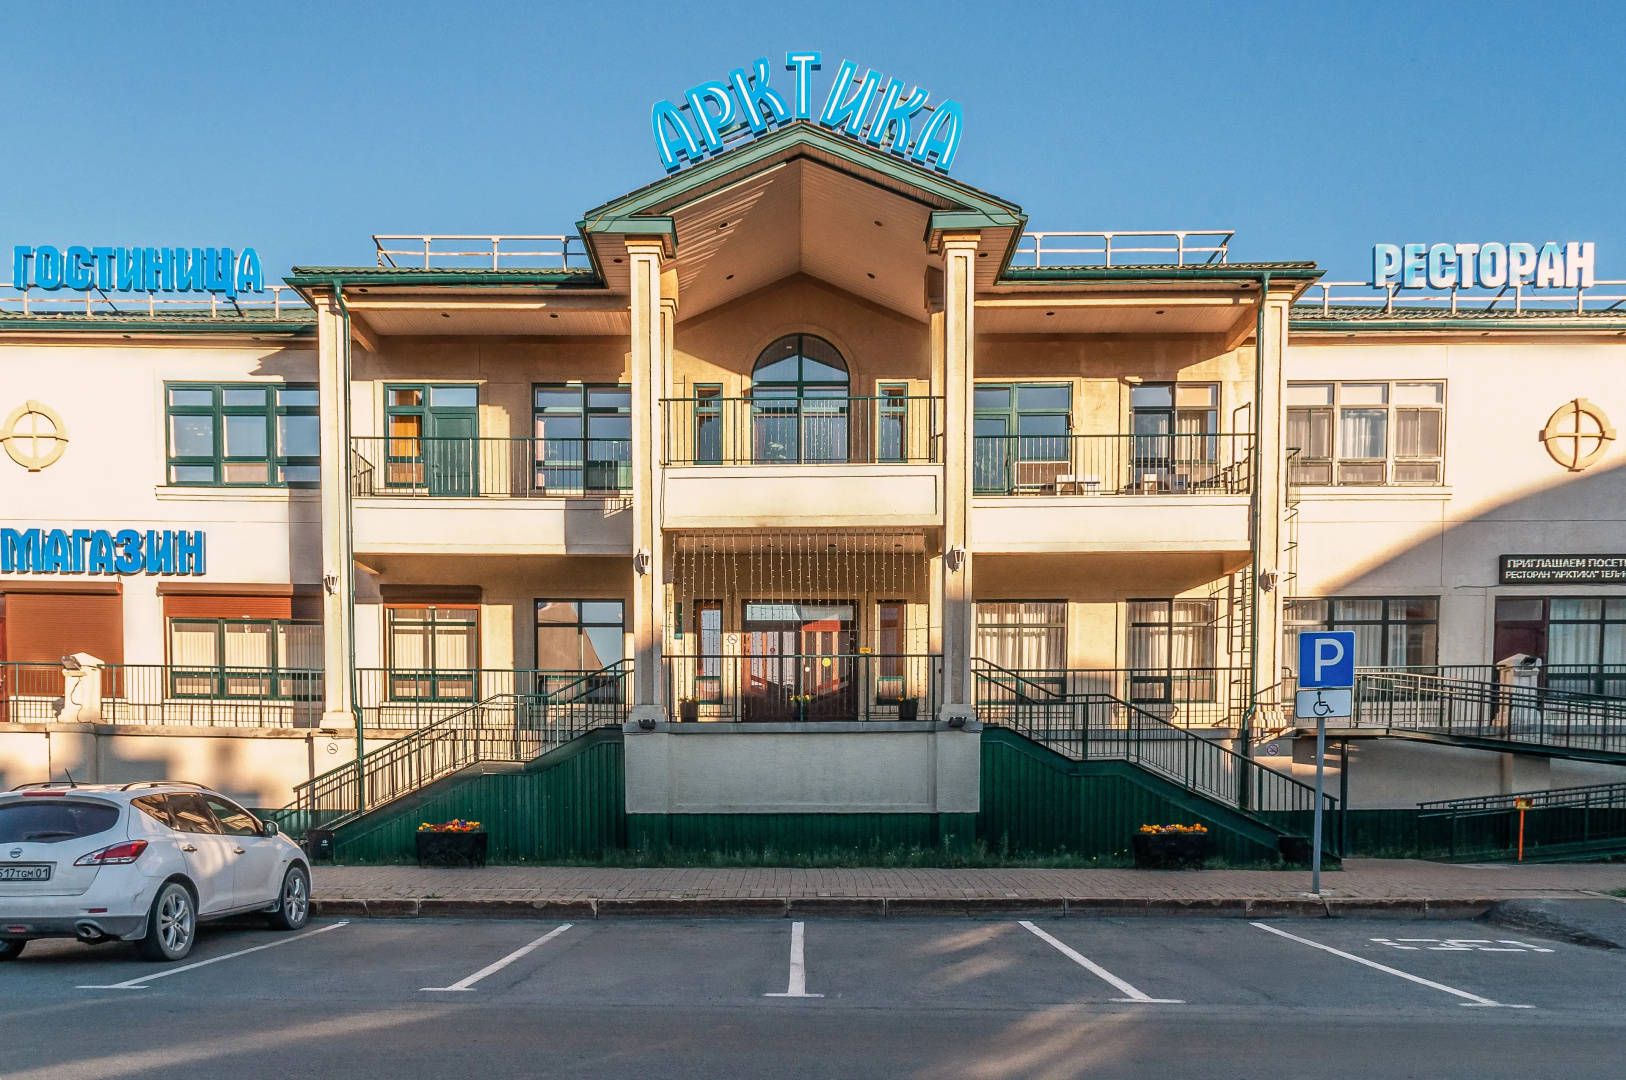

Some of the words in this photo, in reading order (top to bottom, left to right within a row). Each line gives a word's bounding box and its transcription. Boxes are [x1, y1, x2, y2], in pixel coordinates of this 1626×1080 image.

[651, 51, 964, 175] АРКТИКА
[12, 245, 265, 301] ГОСТИНИЦА
[1372, 241, 1595, 290] РЕСТОРАН
[0, 527, 207, 577] МАГАЗИН
[1505, 570, 1551, 579] РЕСТОРАН
[1551, 570, 1600, 579] "АРКТИКА"
[1506, 558, 1586, 568] ПРИГЛАШАЕМ
[1314, 638, 1345, 682] P
